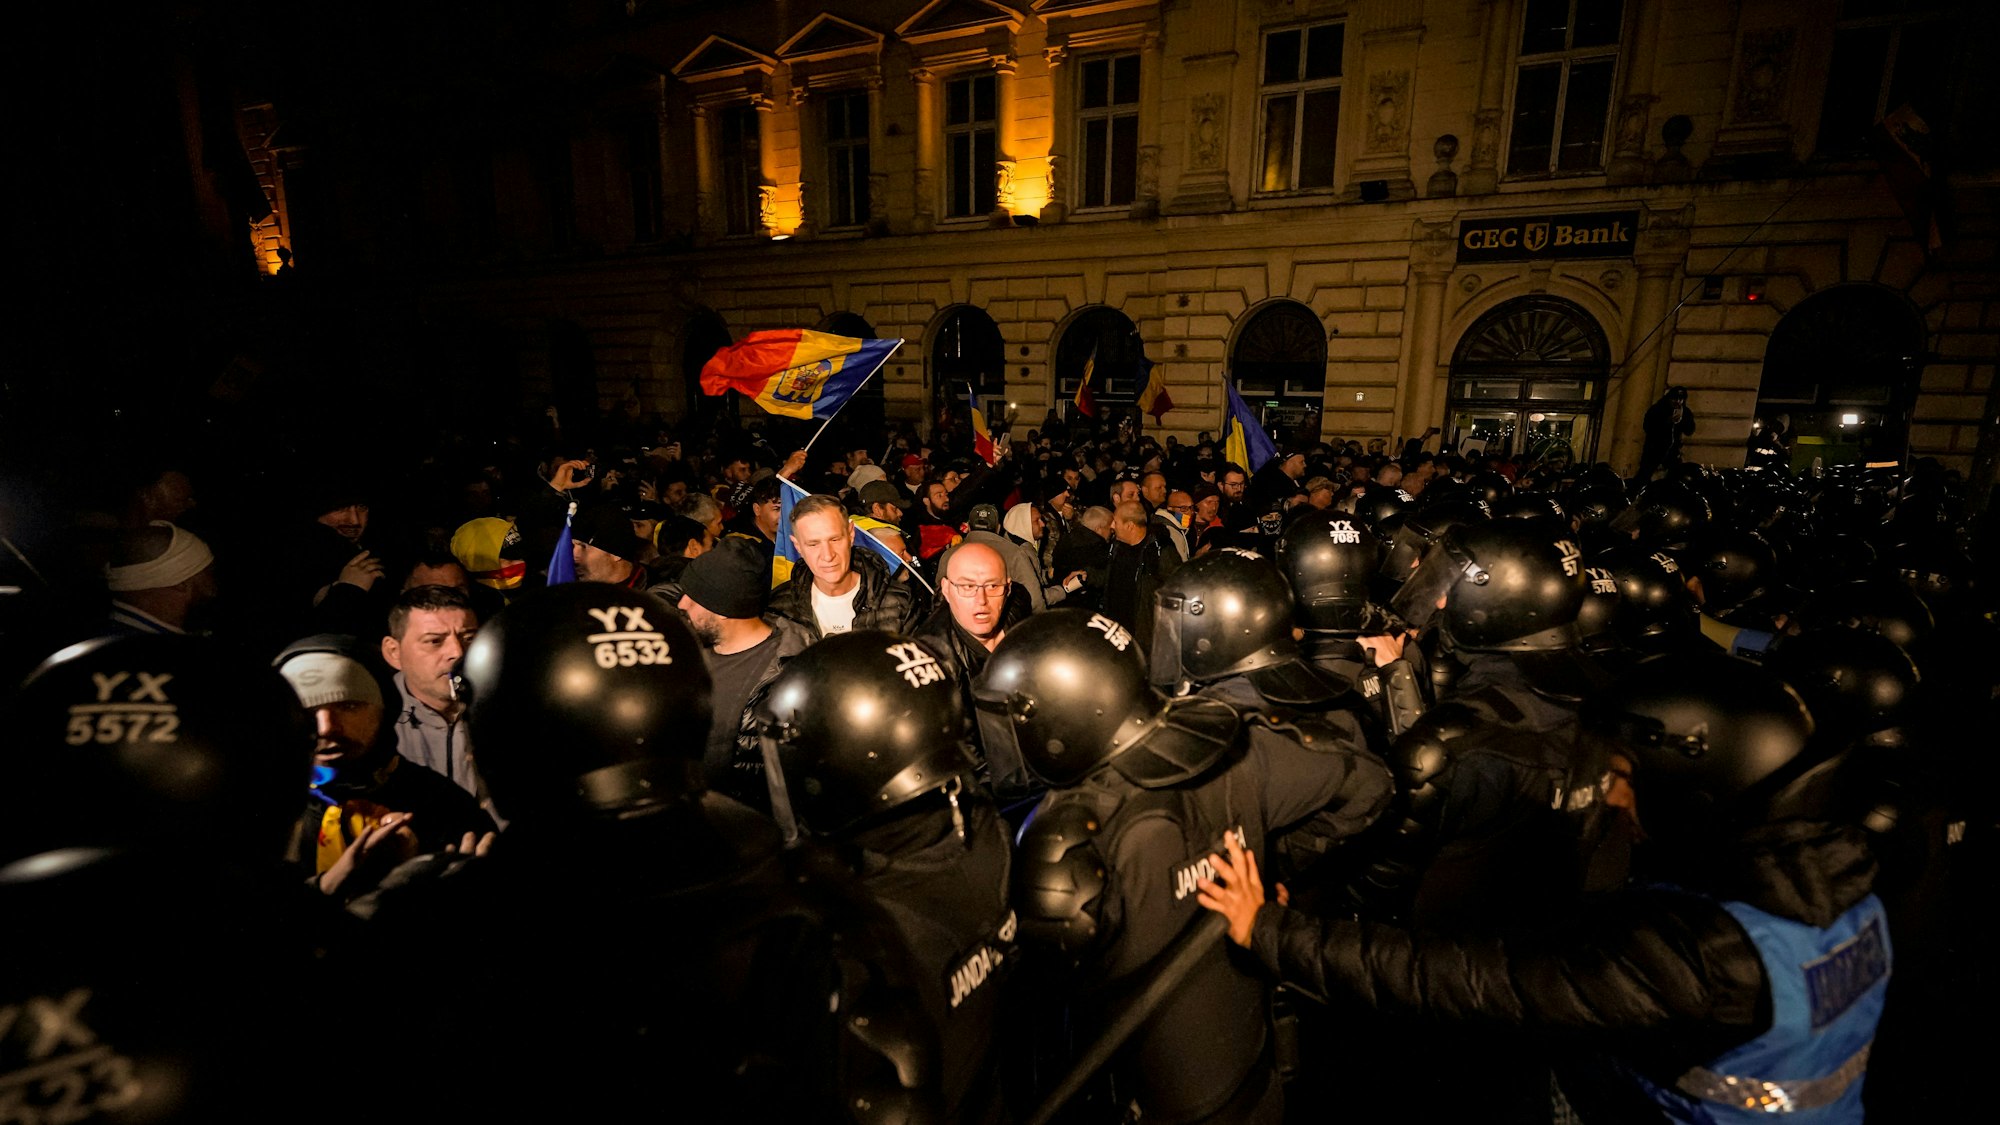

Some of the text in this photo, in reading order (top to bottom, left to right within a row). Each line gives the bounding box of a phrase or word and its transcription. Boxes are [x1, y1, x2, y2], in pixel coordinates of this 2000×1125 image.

[1463, 221, 1629, 250] CEC Bank
[1328, 520, 1355, 531] YX
[1330, 532, 1360, 545] 7081
[1561, 558, 1579, 577] 57
[587, 605, 654, 632] YX
[594, 639, 673, 669] 6532
[885, 642, 930, 664] YX
[90, 670, 175, 702] YX
[904, 661, 946, 689] 1341
[63, 713, 181, 747] 5572
